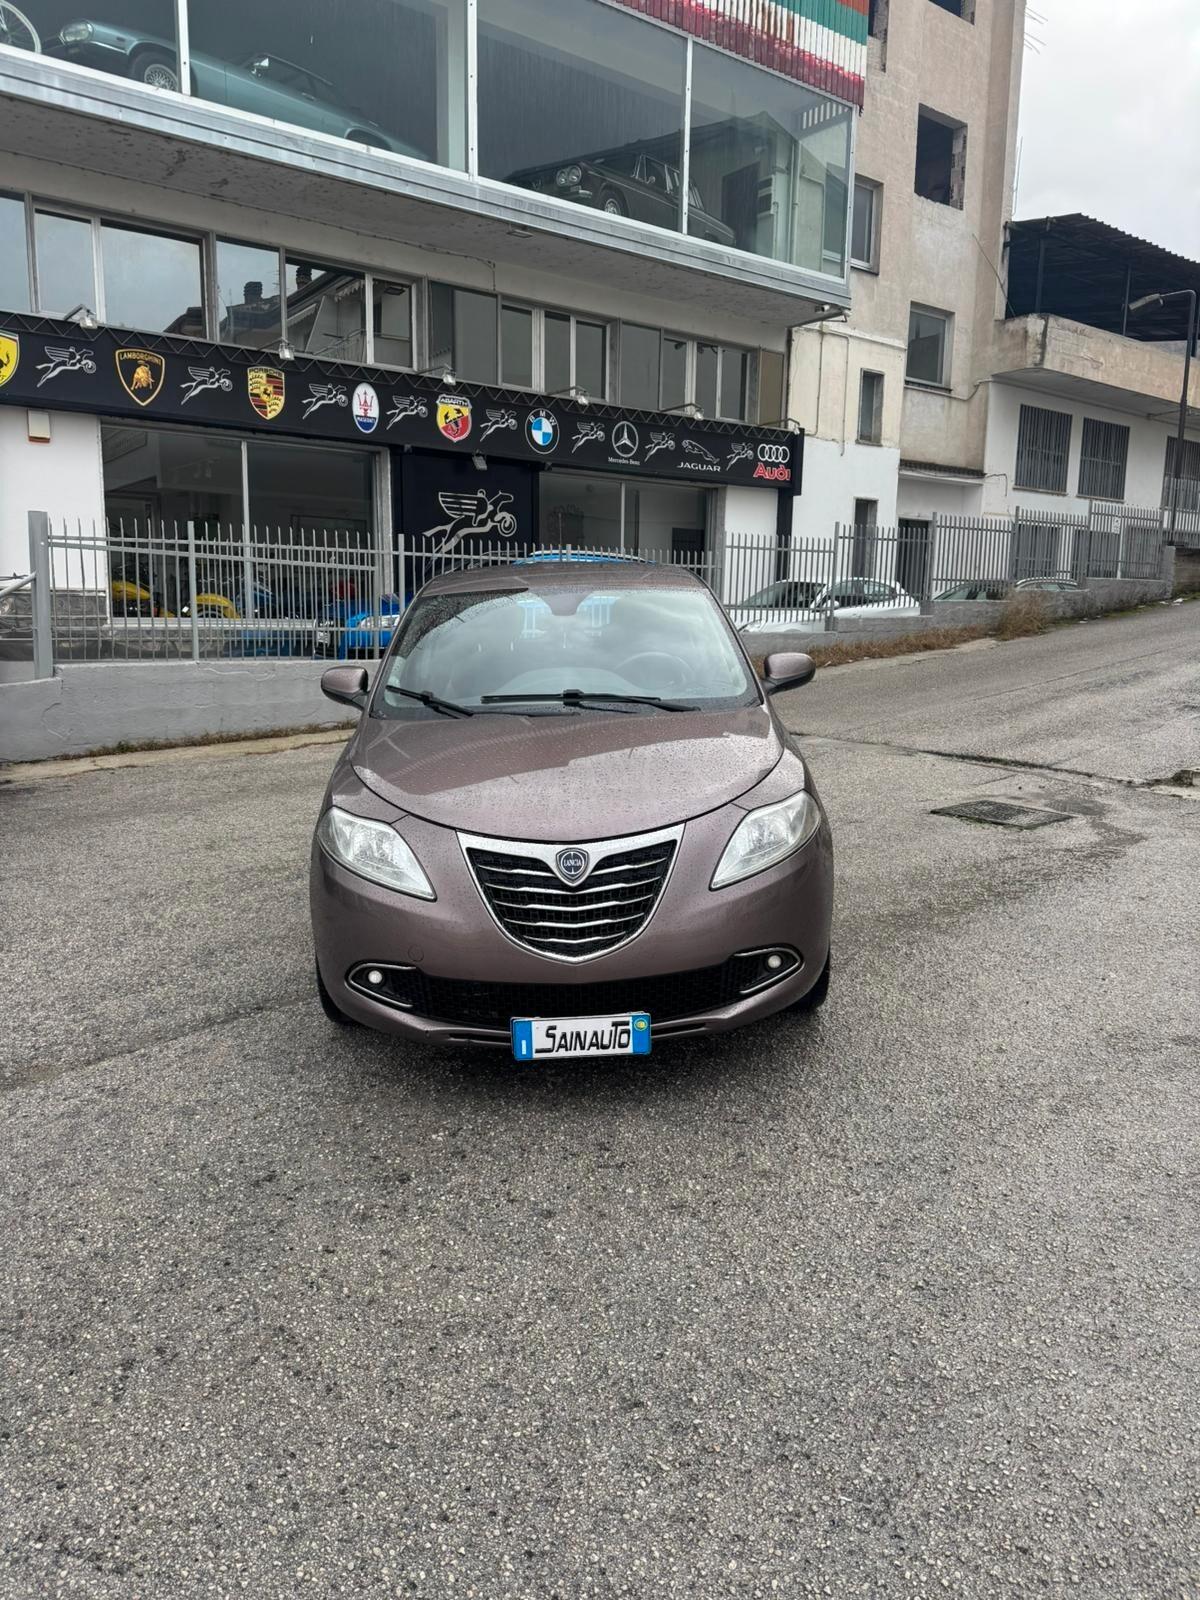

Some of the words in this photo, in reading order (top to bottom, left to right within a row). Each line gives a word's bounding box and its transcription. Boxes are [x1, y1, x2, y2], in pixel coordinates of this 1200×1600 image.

[529, 410, 557, 426] BMW
[677, 461, 721, 472] JAGUAR
[753, 462, 791, 481] Audi
[563, 859, 581, 867] LANCIA
